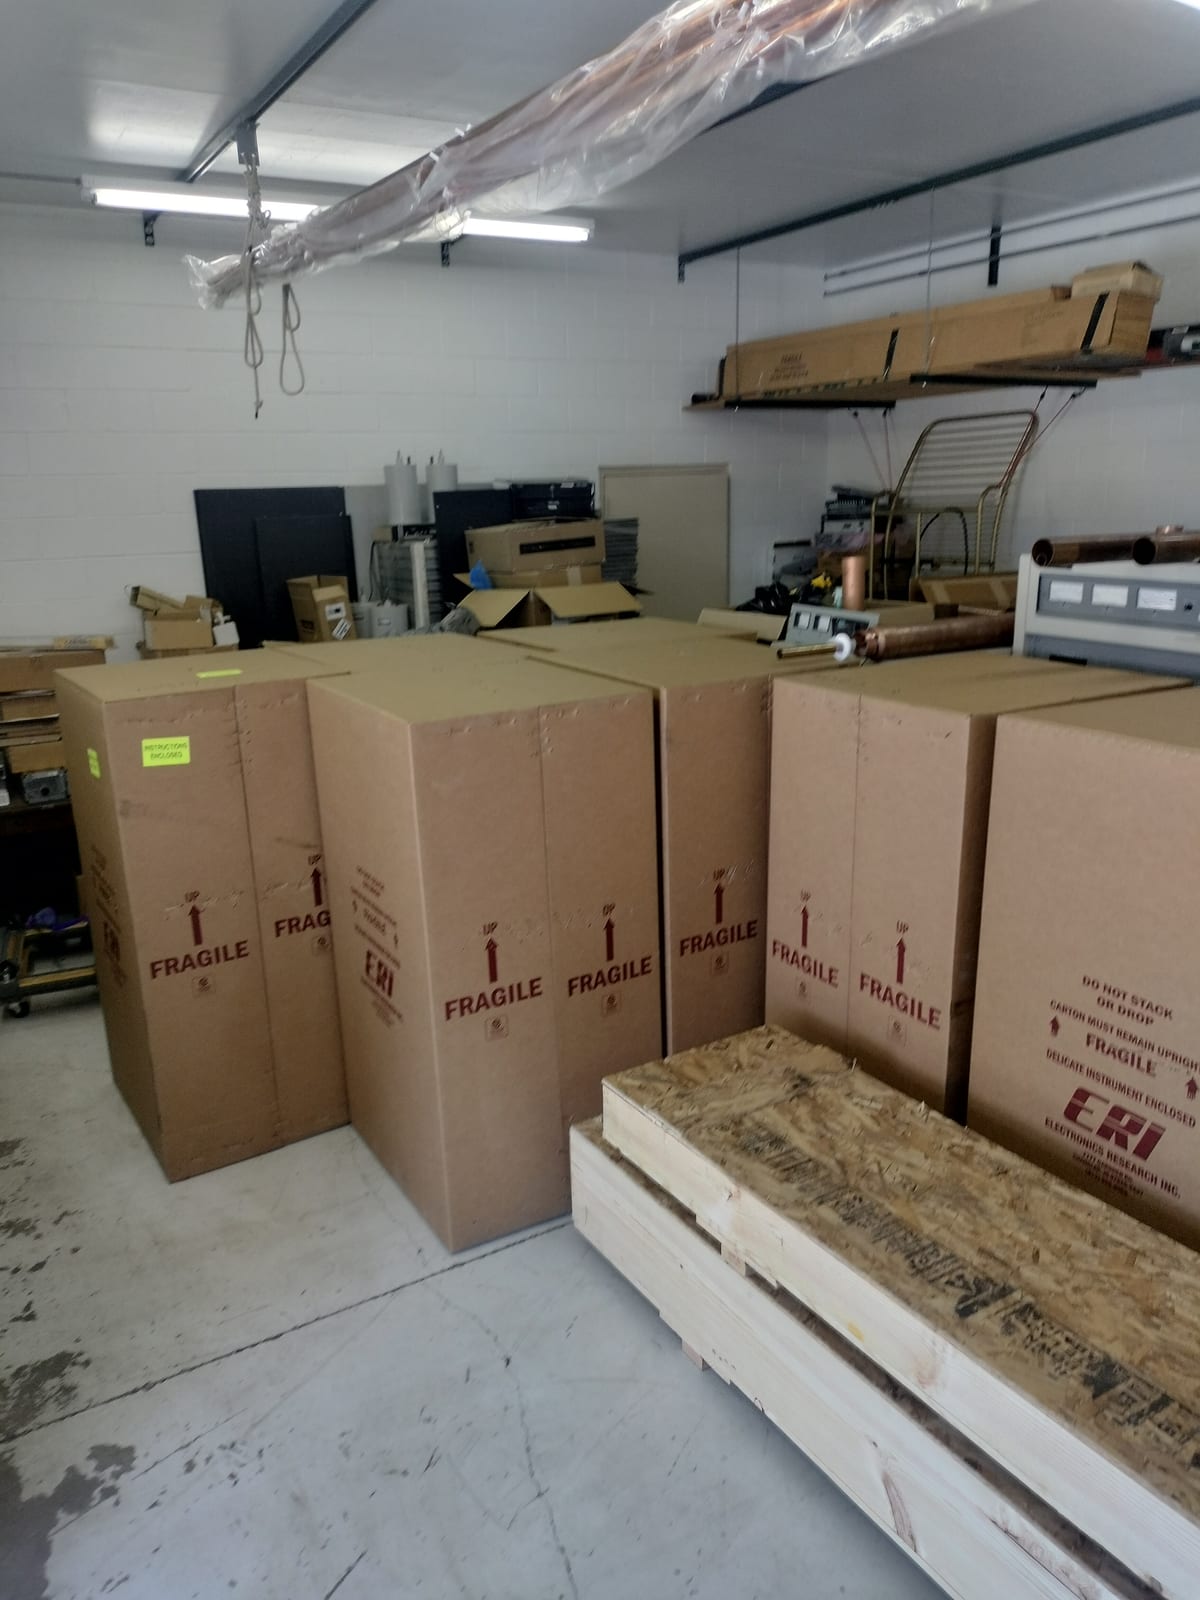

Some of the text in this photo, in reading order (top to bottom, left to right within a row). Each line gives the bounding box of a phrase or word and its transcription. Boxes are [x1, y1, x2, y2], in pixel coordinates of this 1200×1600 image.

[150, 751, 183, 760] ENCLOSED
[308, 853, 323, 866] UP
[712, 868, 726, 880] UP
[184, 890, 200, 903] UP
[602, 902, 616, 916] UP
[799, 889, 812, 901] UP
[482, 921, 498, 935] UP
[679, 919, 759, 957] FRAGILE
[896, 919, 909, 934] UP
[149, 939, 250, 979] FRAGILE
[567, 955, 653, 998] FRAGILE
[772, 939, 840, 989] FRAGILE
[444, 976, 543, 1021] FRAGILE
[859, 971, 942, 1030] FRAGILE
[1082, 975, 1174, 1021] DO NOT STACK
[1097, 996, 1155, 1025] OR DROP
[1050, 999, 1200, 1075] CARTON MUST REMAIN UPRIGH
[1086, 1032, 1157, 1078] FRAGILE
[1046, 1048, 1196, 1128] DELICATE INSTRUMENT ENCLOSED
[1063, 1086, 1166, 1162] ERI
[1044, 1116, 1105, 1155] ELECTRONICS
[1106, 1149, 1158, 1186] RESEARCH
[1160, 1178, 1181, 1199] INC.
